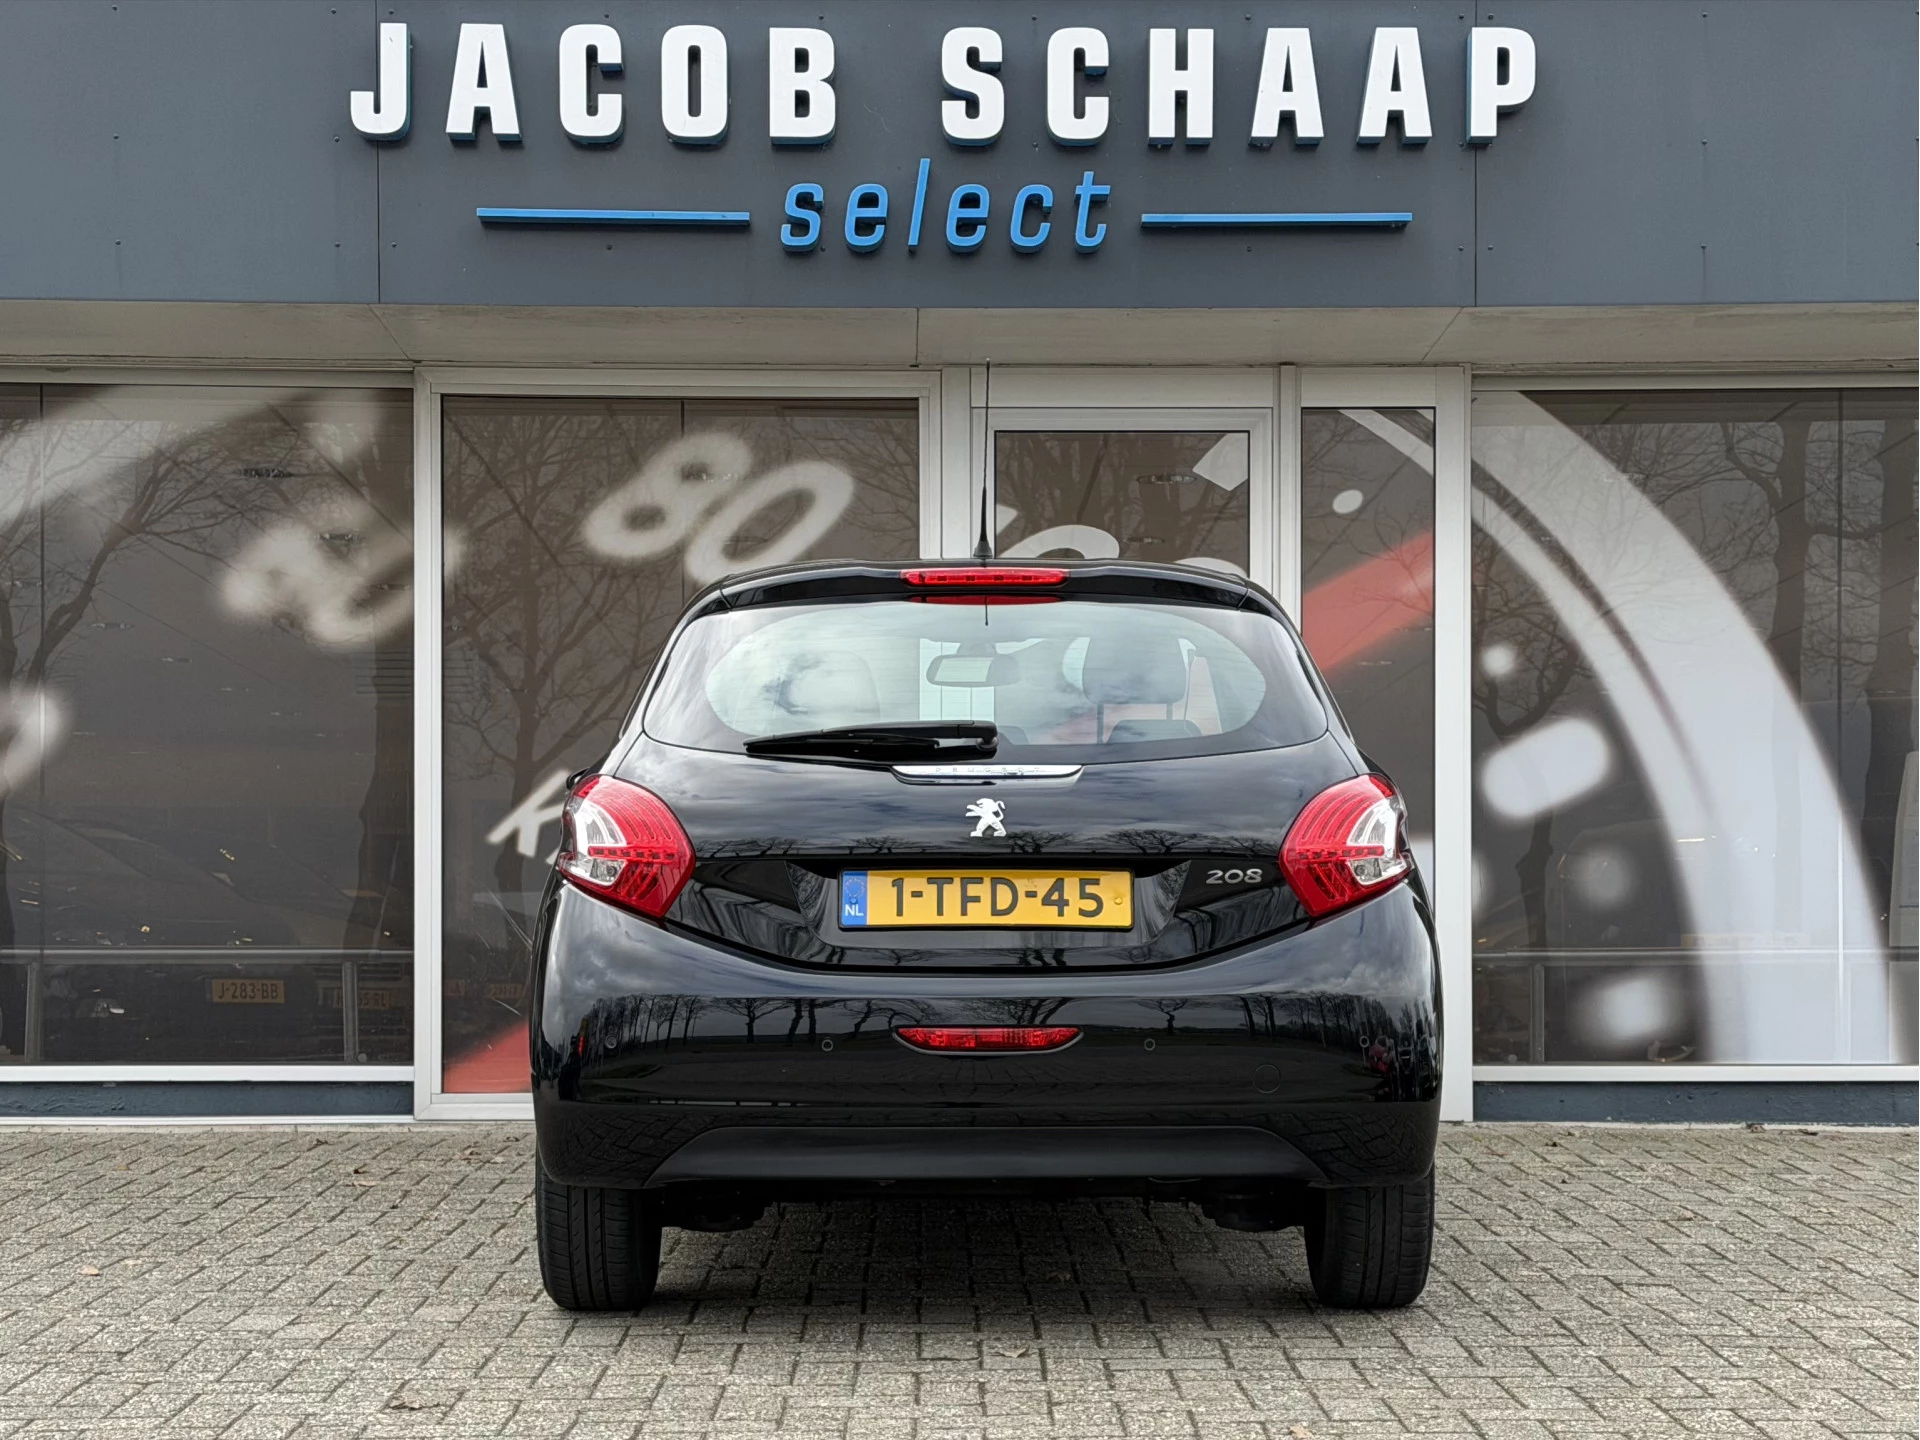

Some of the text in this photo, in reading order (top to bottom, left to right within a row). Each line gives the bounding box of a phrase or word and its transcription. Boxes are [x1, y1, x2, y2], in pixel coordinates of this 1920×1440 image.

[350, 22, 1537, 147] JACOB SCHAAP
[780, 158, 1112, 254] select
[582, 432, 856, 586] 80
[844, 877, 1104, 919] NL 1-TFD-45
[1205, 868, 1263, 885] 208
[218, 982, 280, 1000] J-283-BB
